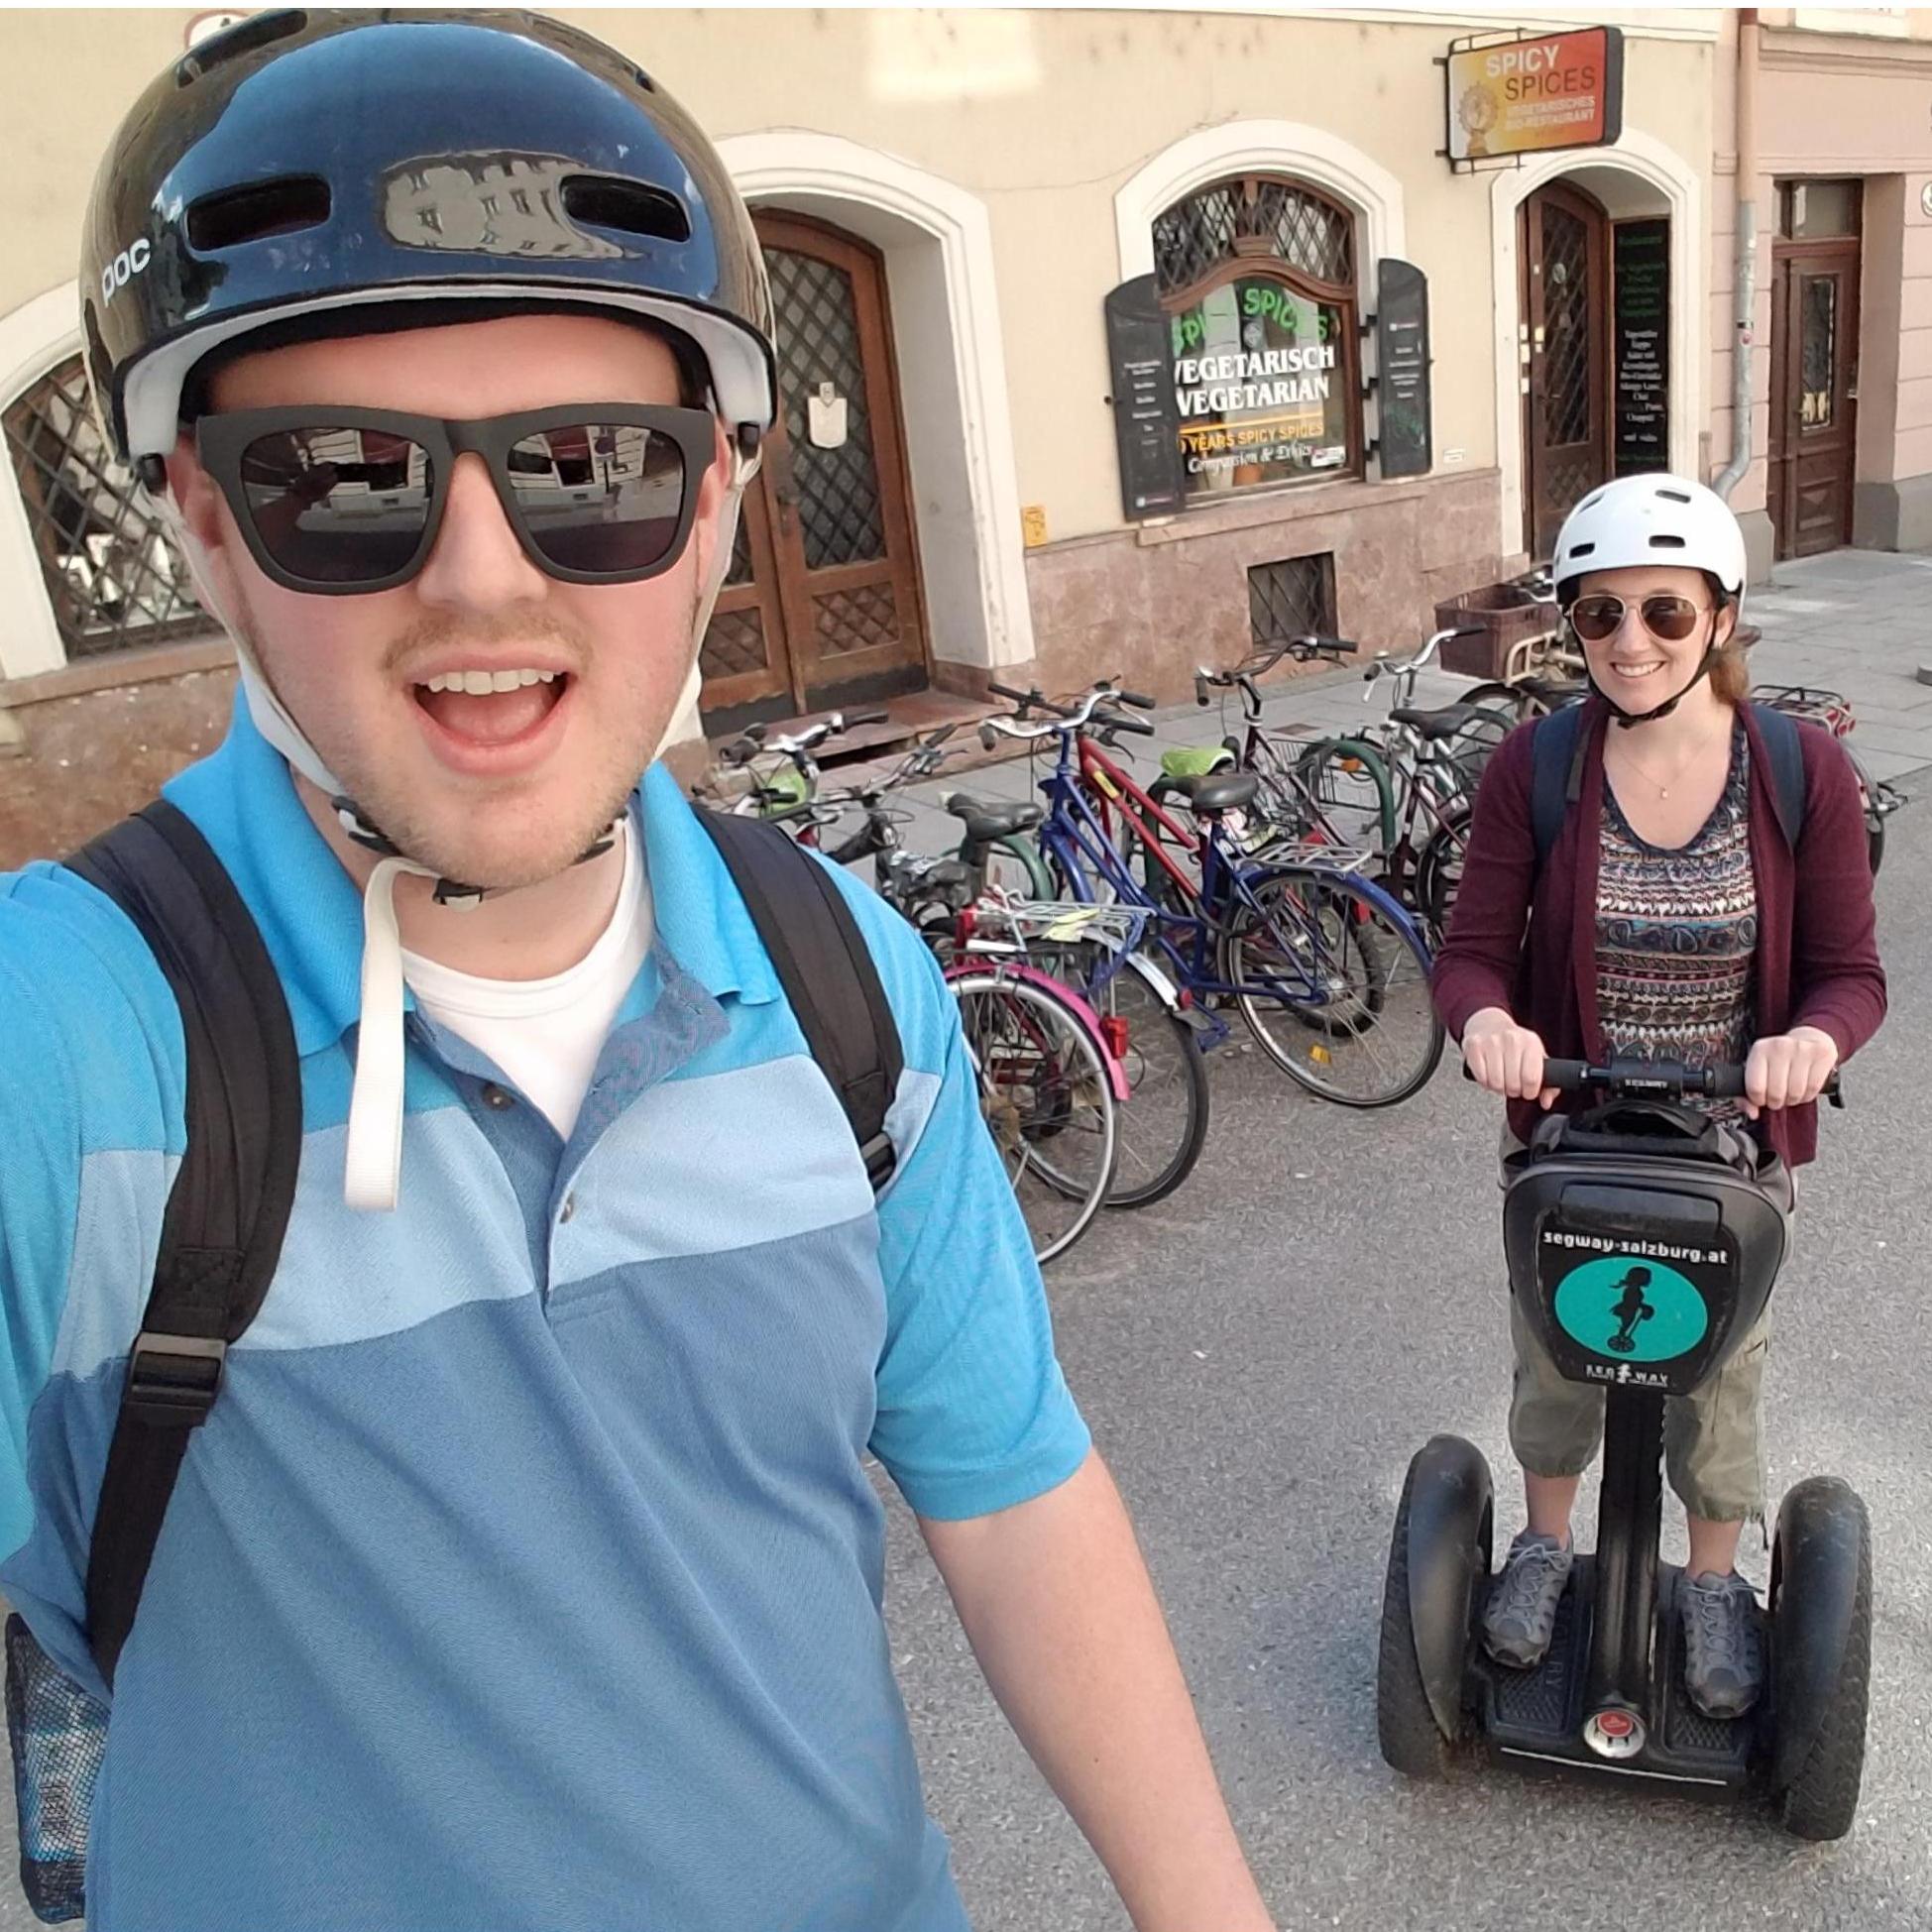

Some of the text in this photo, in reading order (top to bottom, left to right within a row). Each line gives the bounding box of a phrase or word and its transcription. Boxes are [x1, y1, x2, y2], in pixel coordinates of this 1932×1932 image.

[1486, 45, 1560, 77] SPICY
[1505, 65, 1596, 101] SPICES
[1243, 288, 1328, 341] SPICS
[1176, 376, 1330, 417] VEGETARIAN
[1189, 433, 1236, 454] YEARS
[1236, 428, 1277, 446] SPICY
[1279, 424, 1324, 441] SPICES
[1542, 1231, 1728, 1265] segway-salzburg.at
